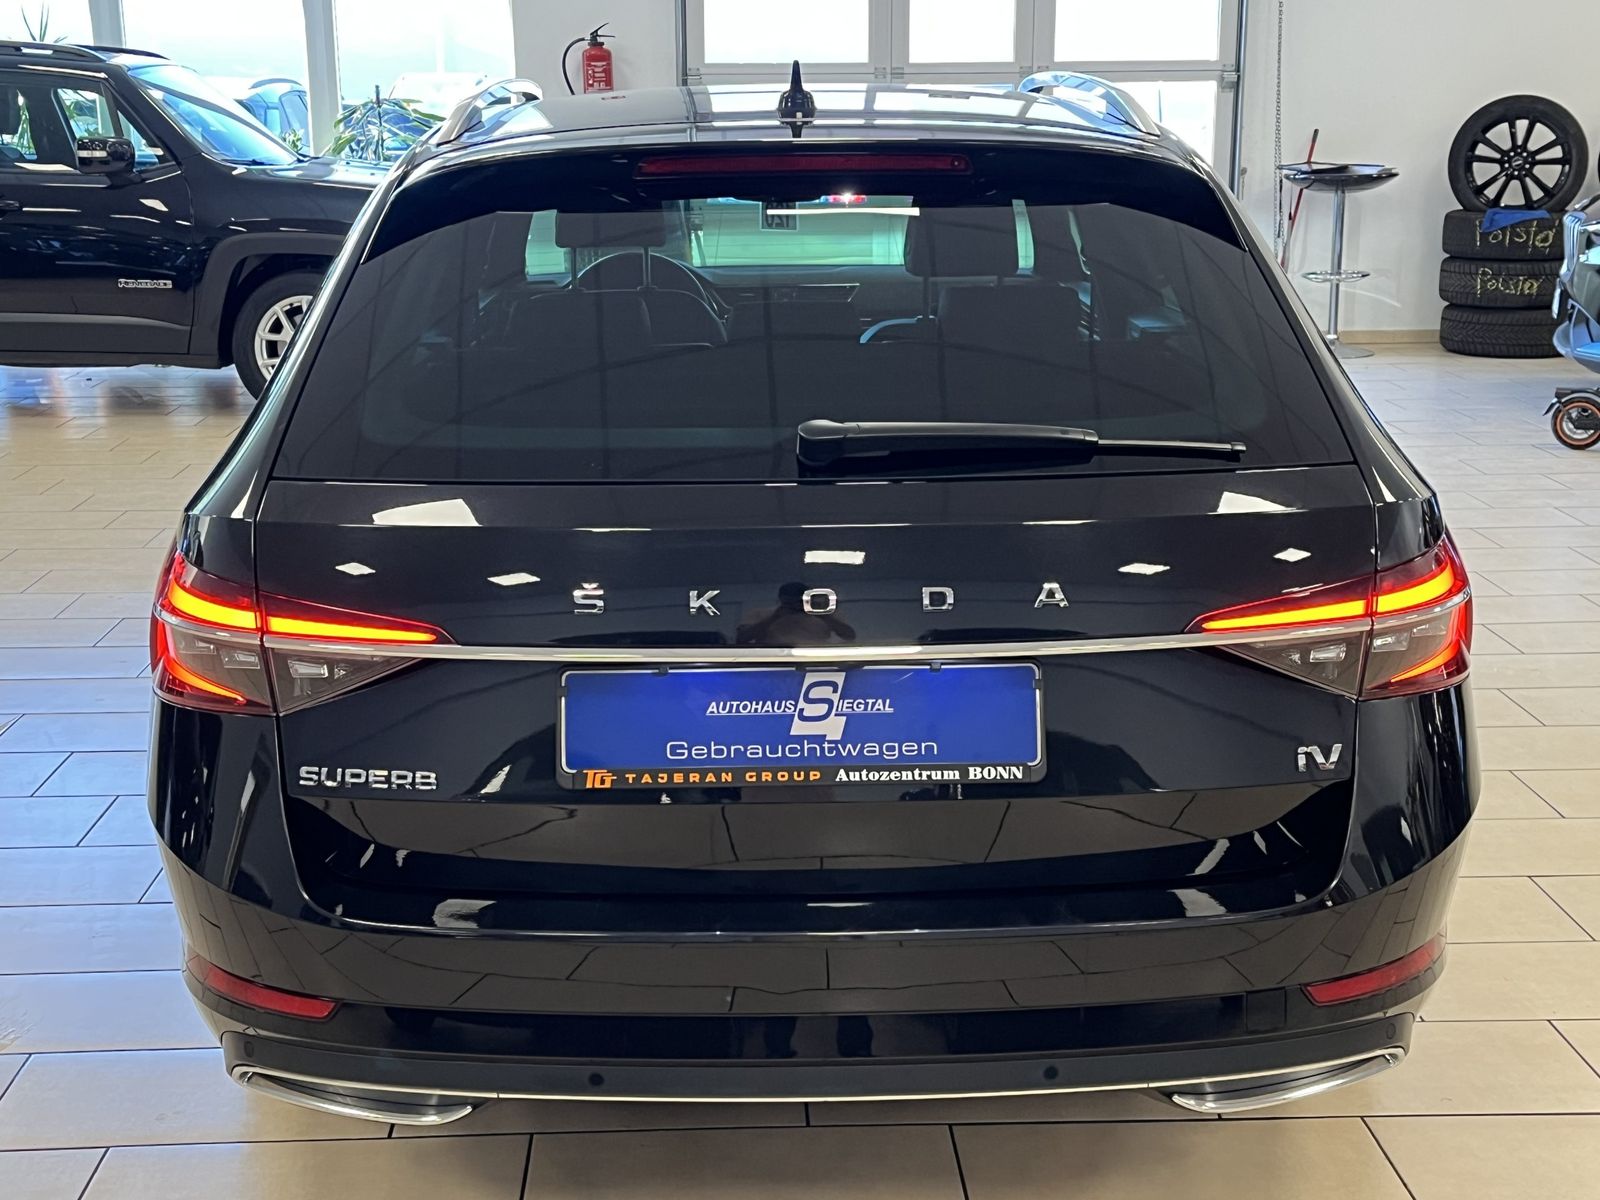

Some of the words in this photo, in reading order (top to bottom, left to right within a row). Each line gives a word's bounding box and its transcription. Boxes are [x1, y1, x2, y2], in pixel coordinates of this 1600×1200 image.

[706, 700, 796, 714] AUTOHAUS
[666, 739, 938, 760] Gebrauchtwagen
[298, 766, 438, 790] SUPERB
[625, 772, 734, 784] TAJERAN
[744, 770, 821, 782] GROUP
[835, 768, 961, 782] Autozentrum
[967, 766, 1024, 780] BONN
